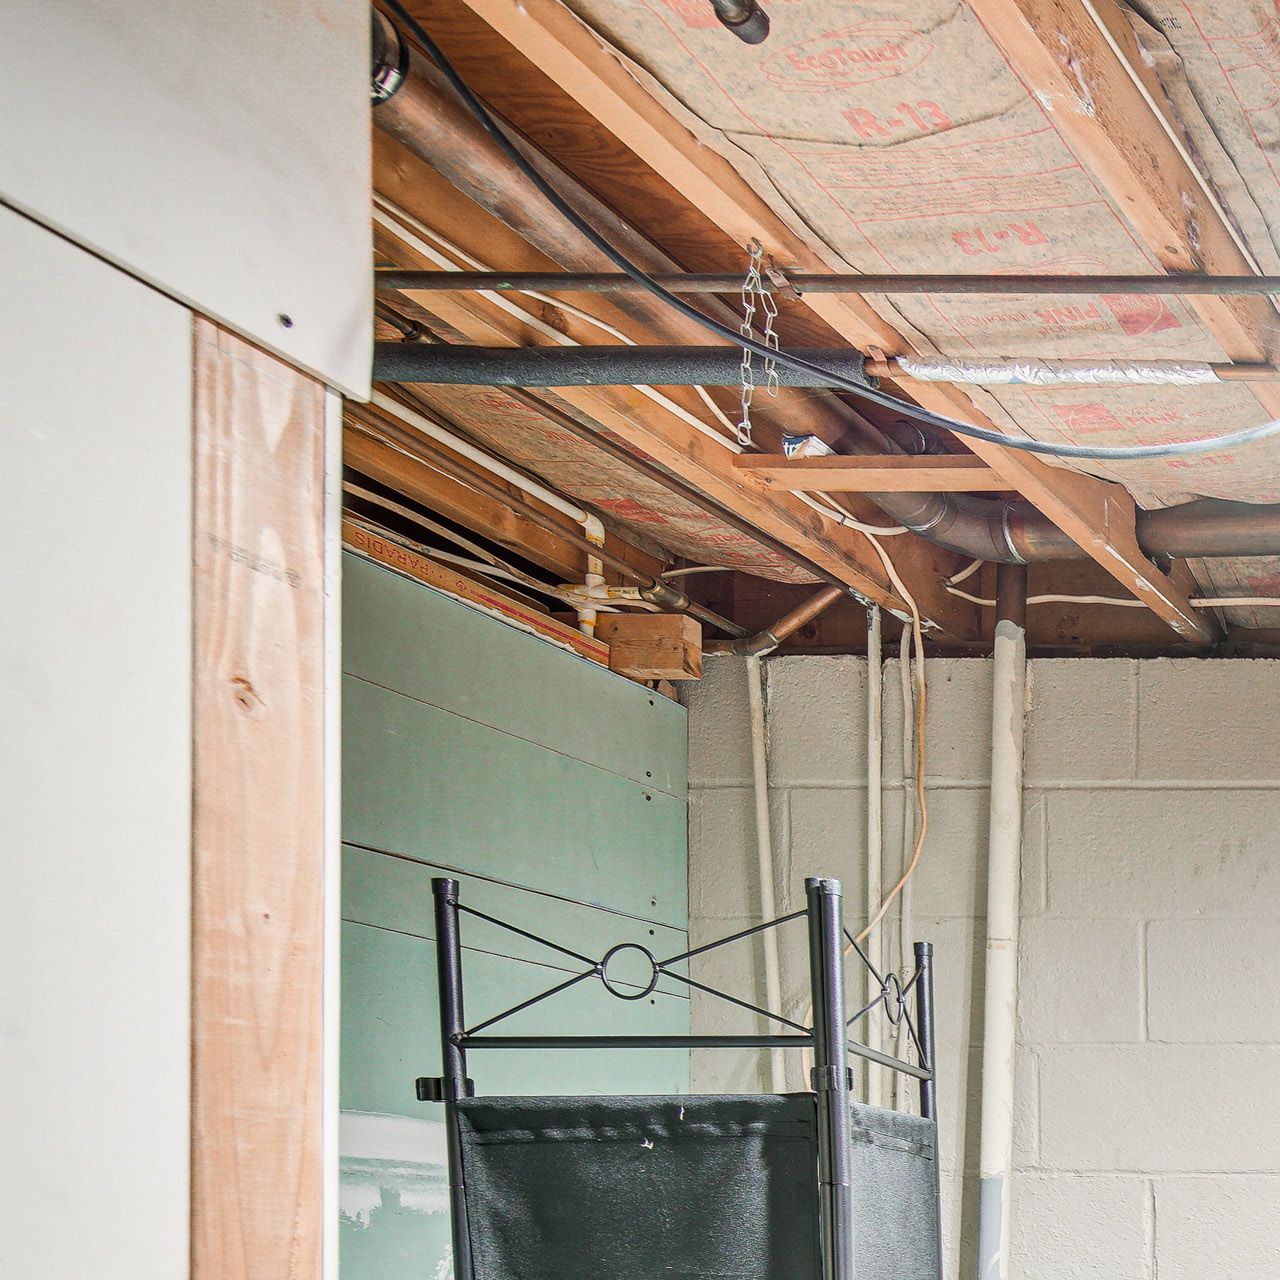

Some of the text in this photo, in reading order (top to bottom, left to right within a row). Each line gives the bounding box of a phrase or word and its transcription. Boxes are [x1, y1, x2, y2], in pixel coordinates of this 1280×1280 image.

[785, 41, 910, 71] EcoTouch
[842, 99, 953, 141] R-13
[951, 221, 1050, 256] R-13
[1033, 302, 1102, 324] PINK
[354, 531, 429, 575] PARADIS
